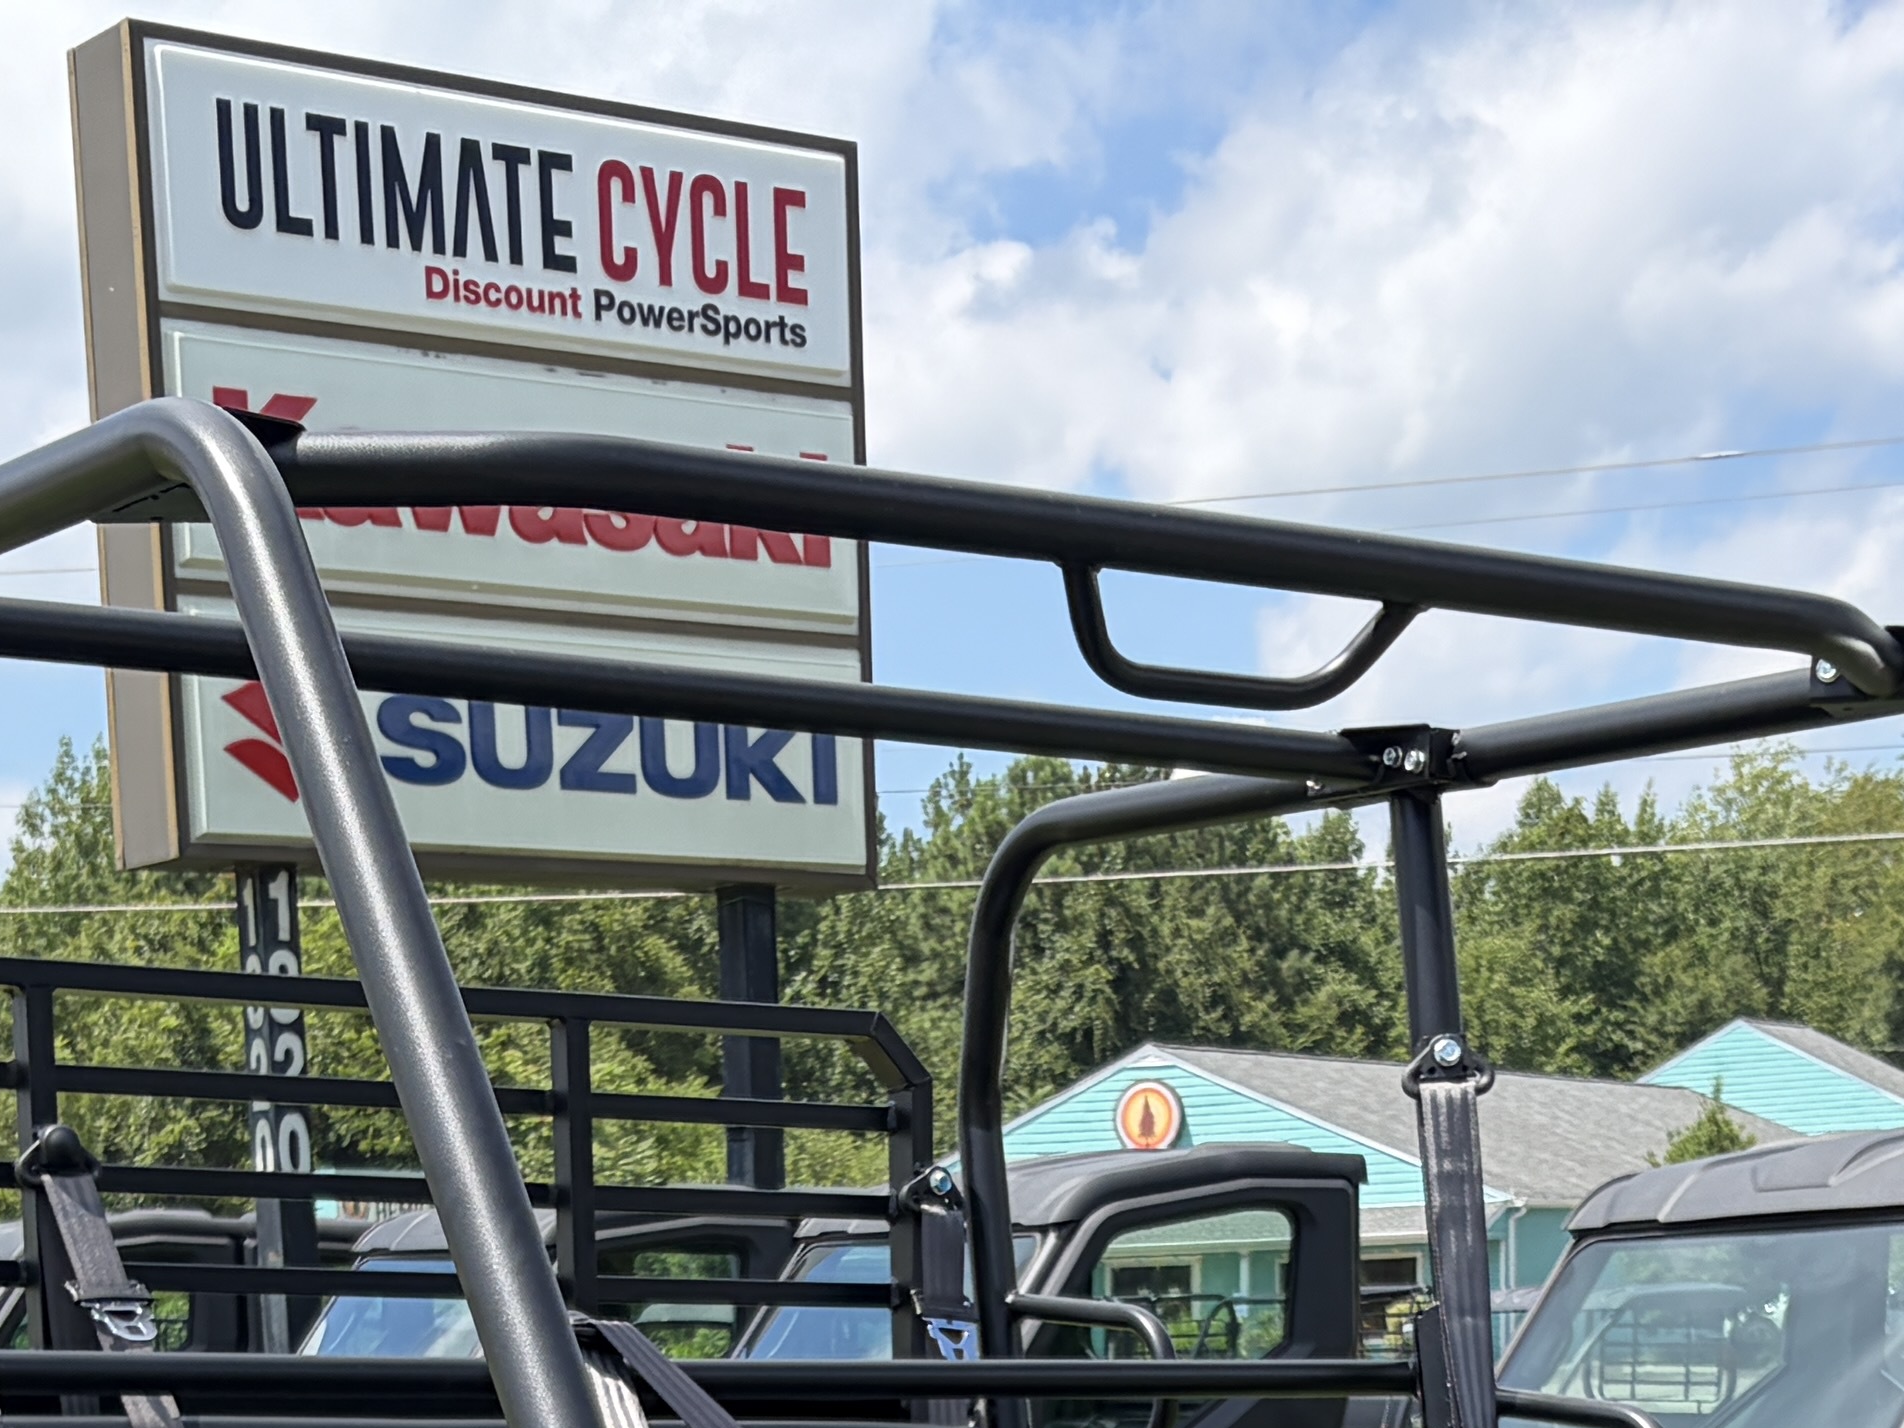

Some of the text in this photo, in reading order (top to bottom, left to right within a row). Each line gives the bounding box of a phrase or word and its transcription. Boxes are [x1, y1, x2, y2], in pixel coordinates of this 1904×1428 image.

[216, 98, 809, 306] ULTIMATE CYCLE
[424, 265, 808, 349] Discount PowerSports
[376, 695, 839, 806] SUZUKI
